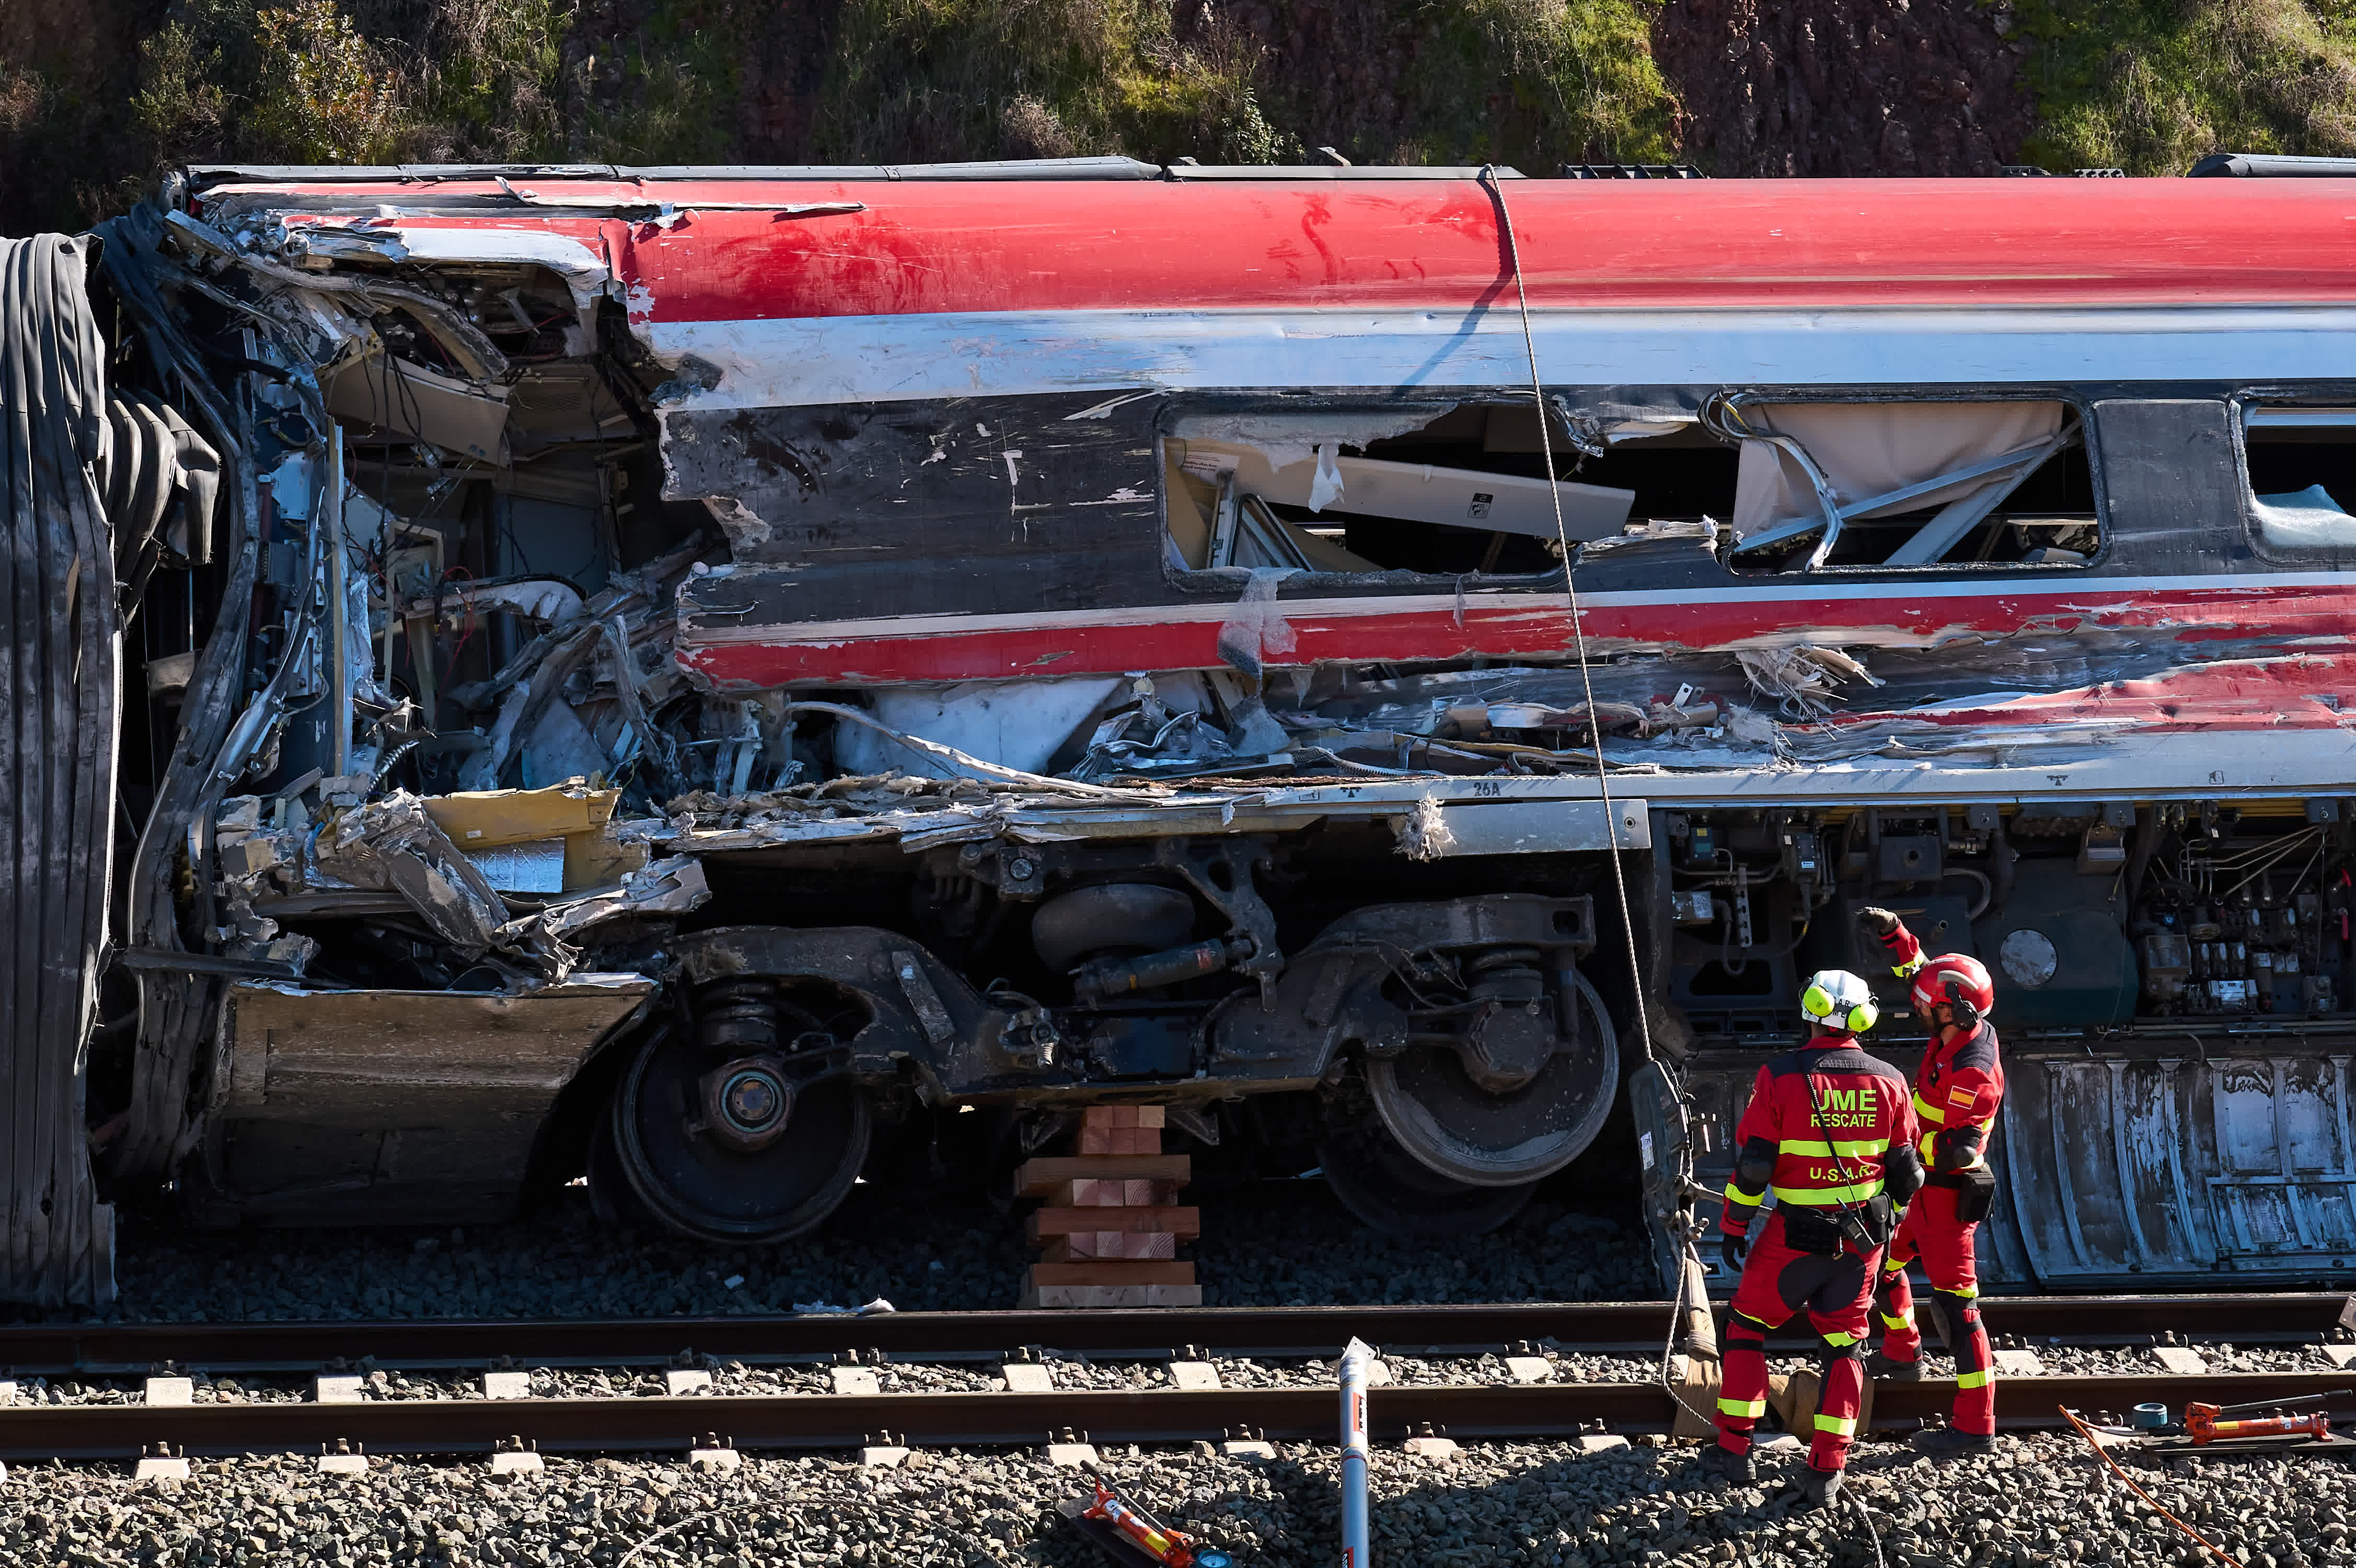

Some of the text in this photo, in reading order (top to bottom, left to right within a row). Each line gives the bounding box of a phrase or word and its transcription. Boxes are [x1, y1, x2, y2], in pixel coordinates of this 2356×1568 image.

[1473, 781, 1502, 796] 26A
[1811, 1089, 1877, 1112] UME
[1810, 1113, 1877, 1127] RESCATE
